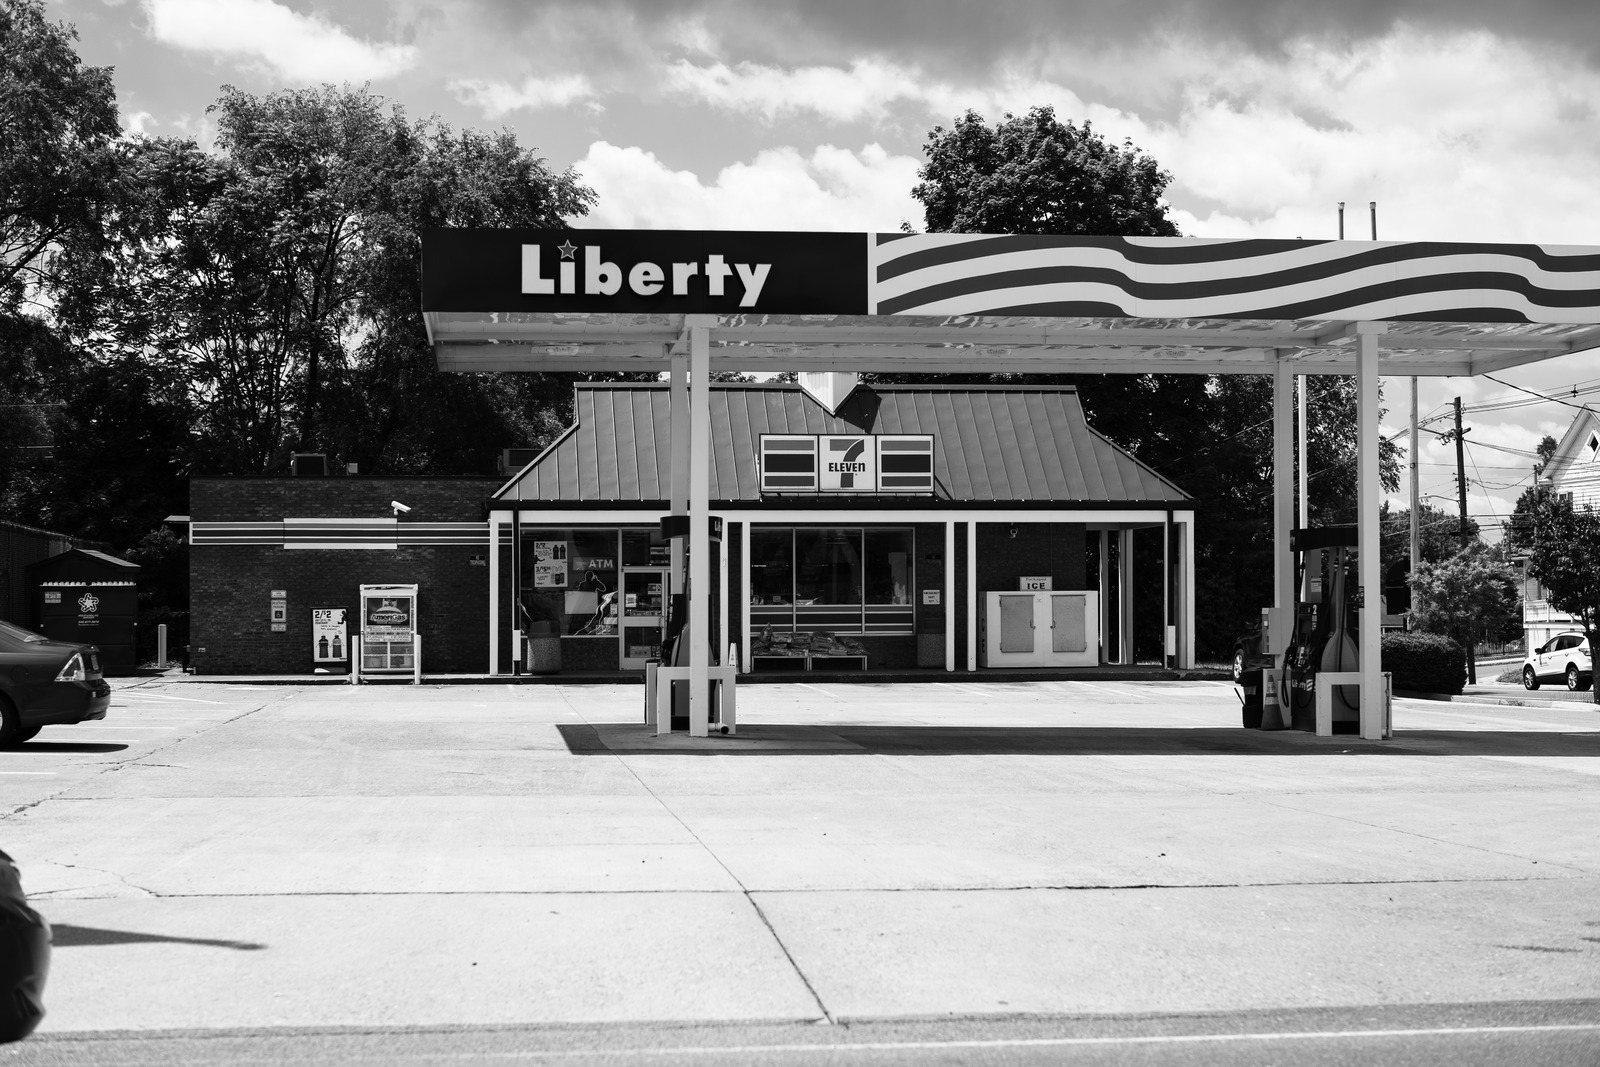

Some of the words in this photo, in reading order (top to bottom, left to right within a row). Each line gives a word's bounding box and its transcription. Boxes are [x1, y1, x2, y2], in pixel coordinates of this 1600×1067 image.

[521, 243, 772, 307] Liberty
[829, 438, 865, 488] 7
[589, 560, 613, 568] ATM
